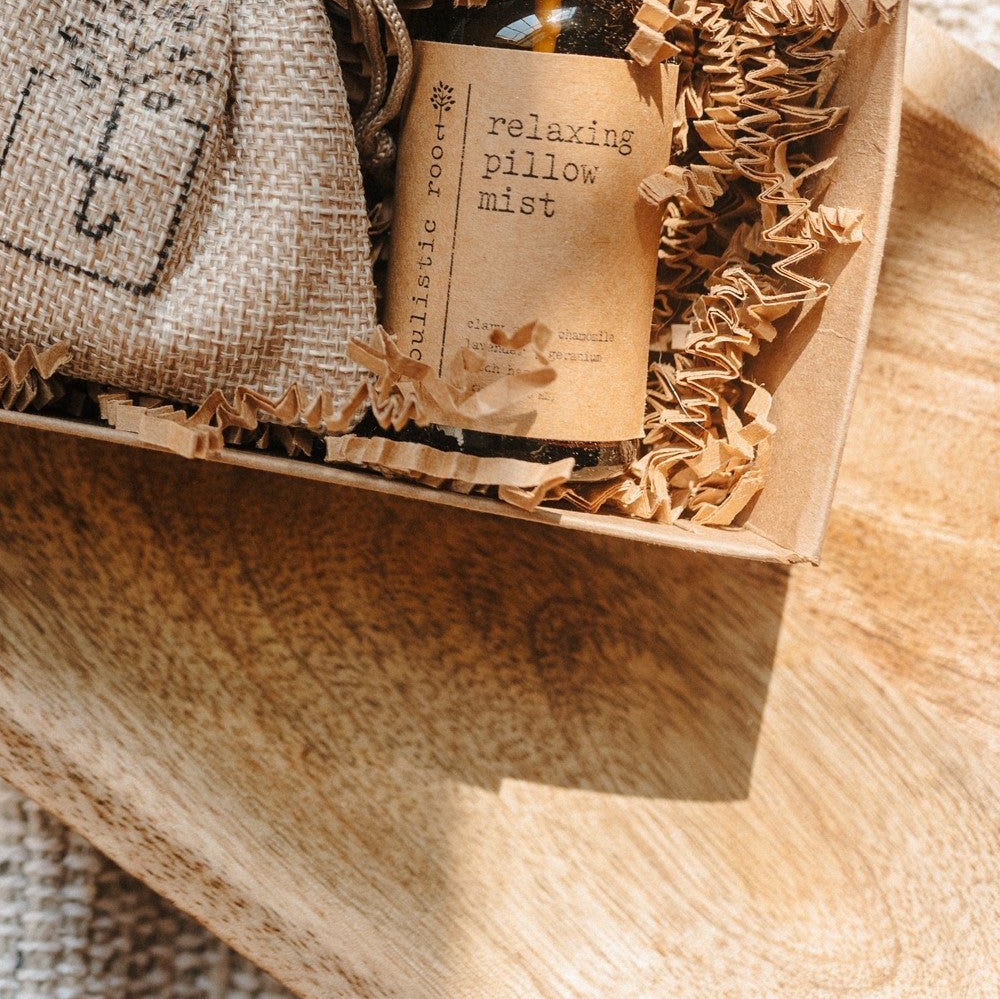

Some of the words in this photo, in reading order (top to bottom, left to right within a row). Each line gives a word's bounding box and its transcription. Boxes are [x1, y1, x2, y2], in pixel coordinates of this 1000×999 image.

[486, 113, 635, 157] relaxing
[480, 149, 600, 186] pillow
[476, 186, 557, 219] mist
[408, 218, 437, 362] oulistic
[427, 116, 446, 199] root
